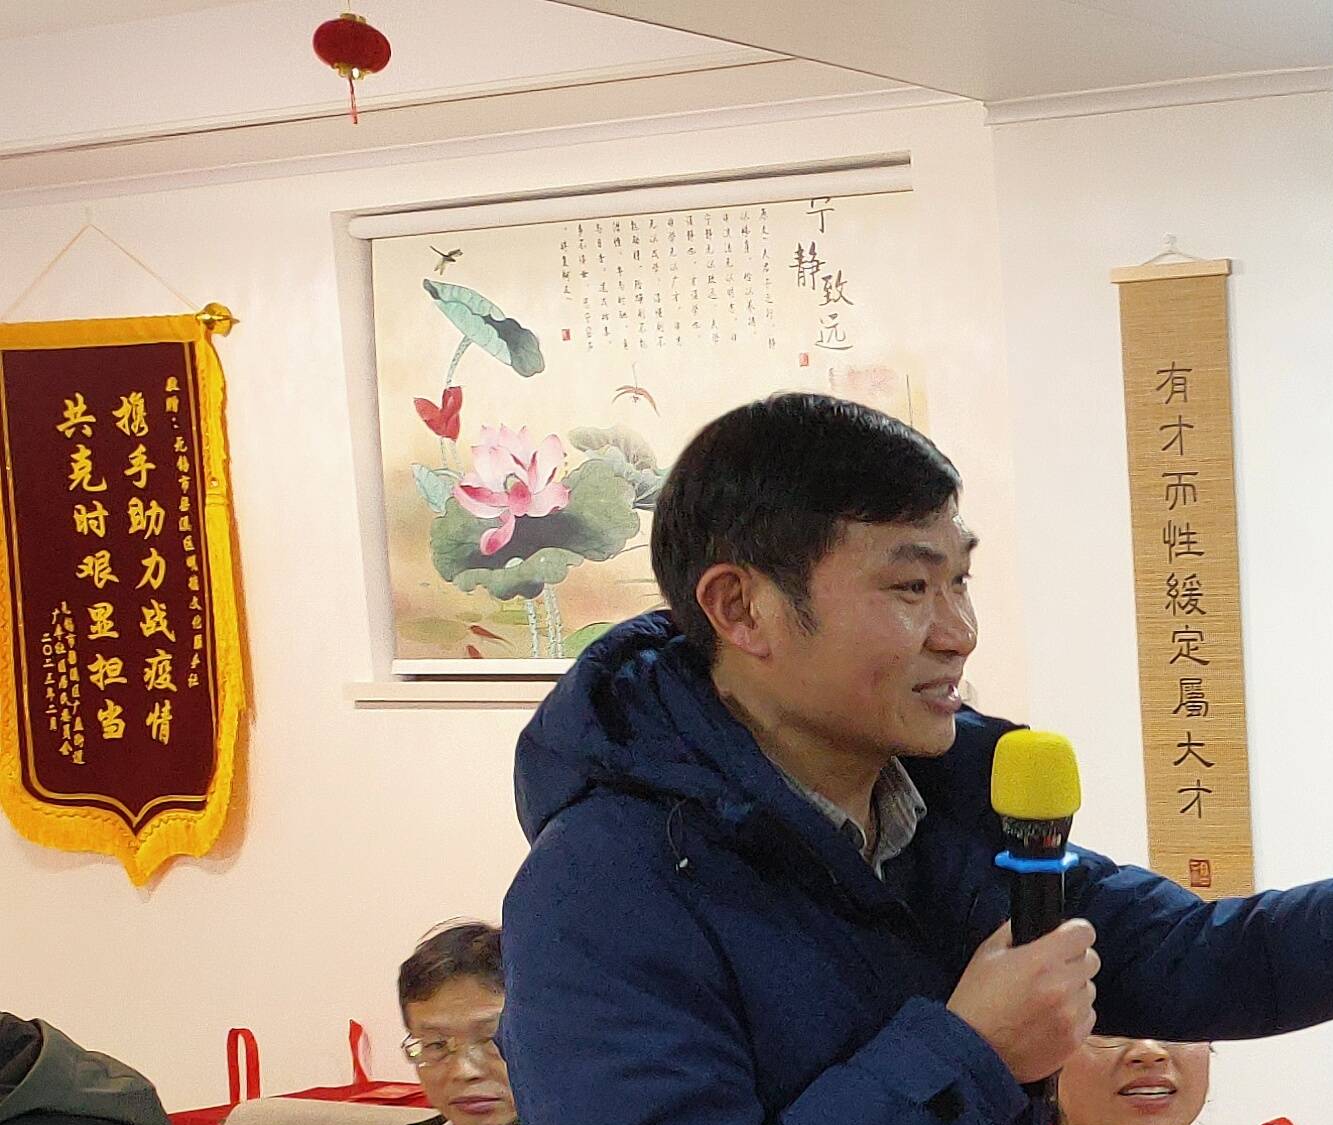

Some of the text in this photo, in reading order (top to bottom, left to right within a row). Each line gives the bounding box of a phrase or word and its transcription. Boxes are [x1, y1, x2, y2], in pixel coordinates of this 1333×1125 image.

[55, 393, 128, 741] 共克时艰显担当
[112, 391, 177, 745] 携手助力战疫情
